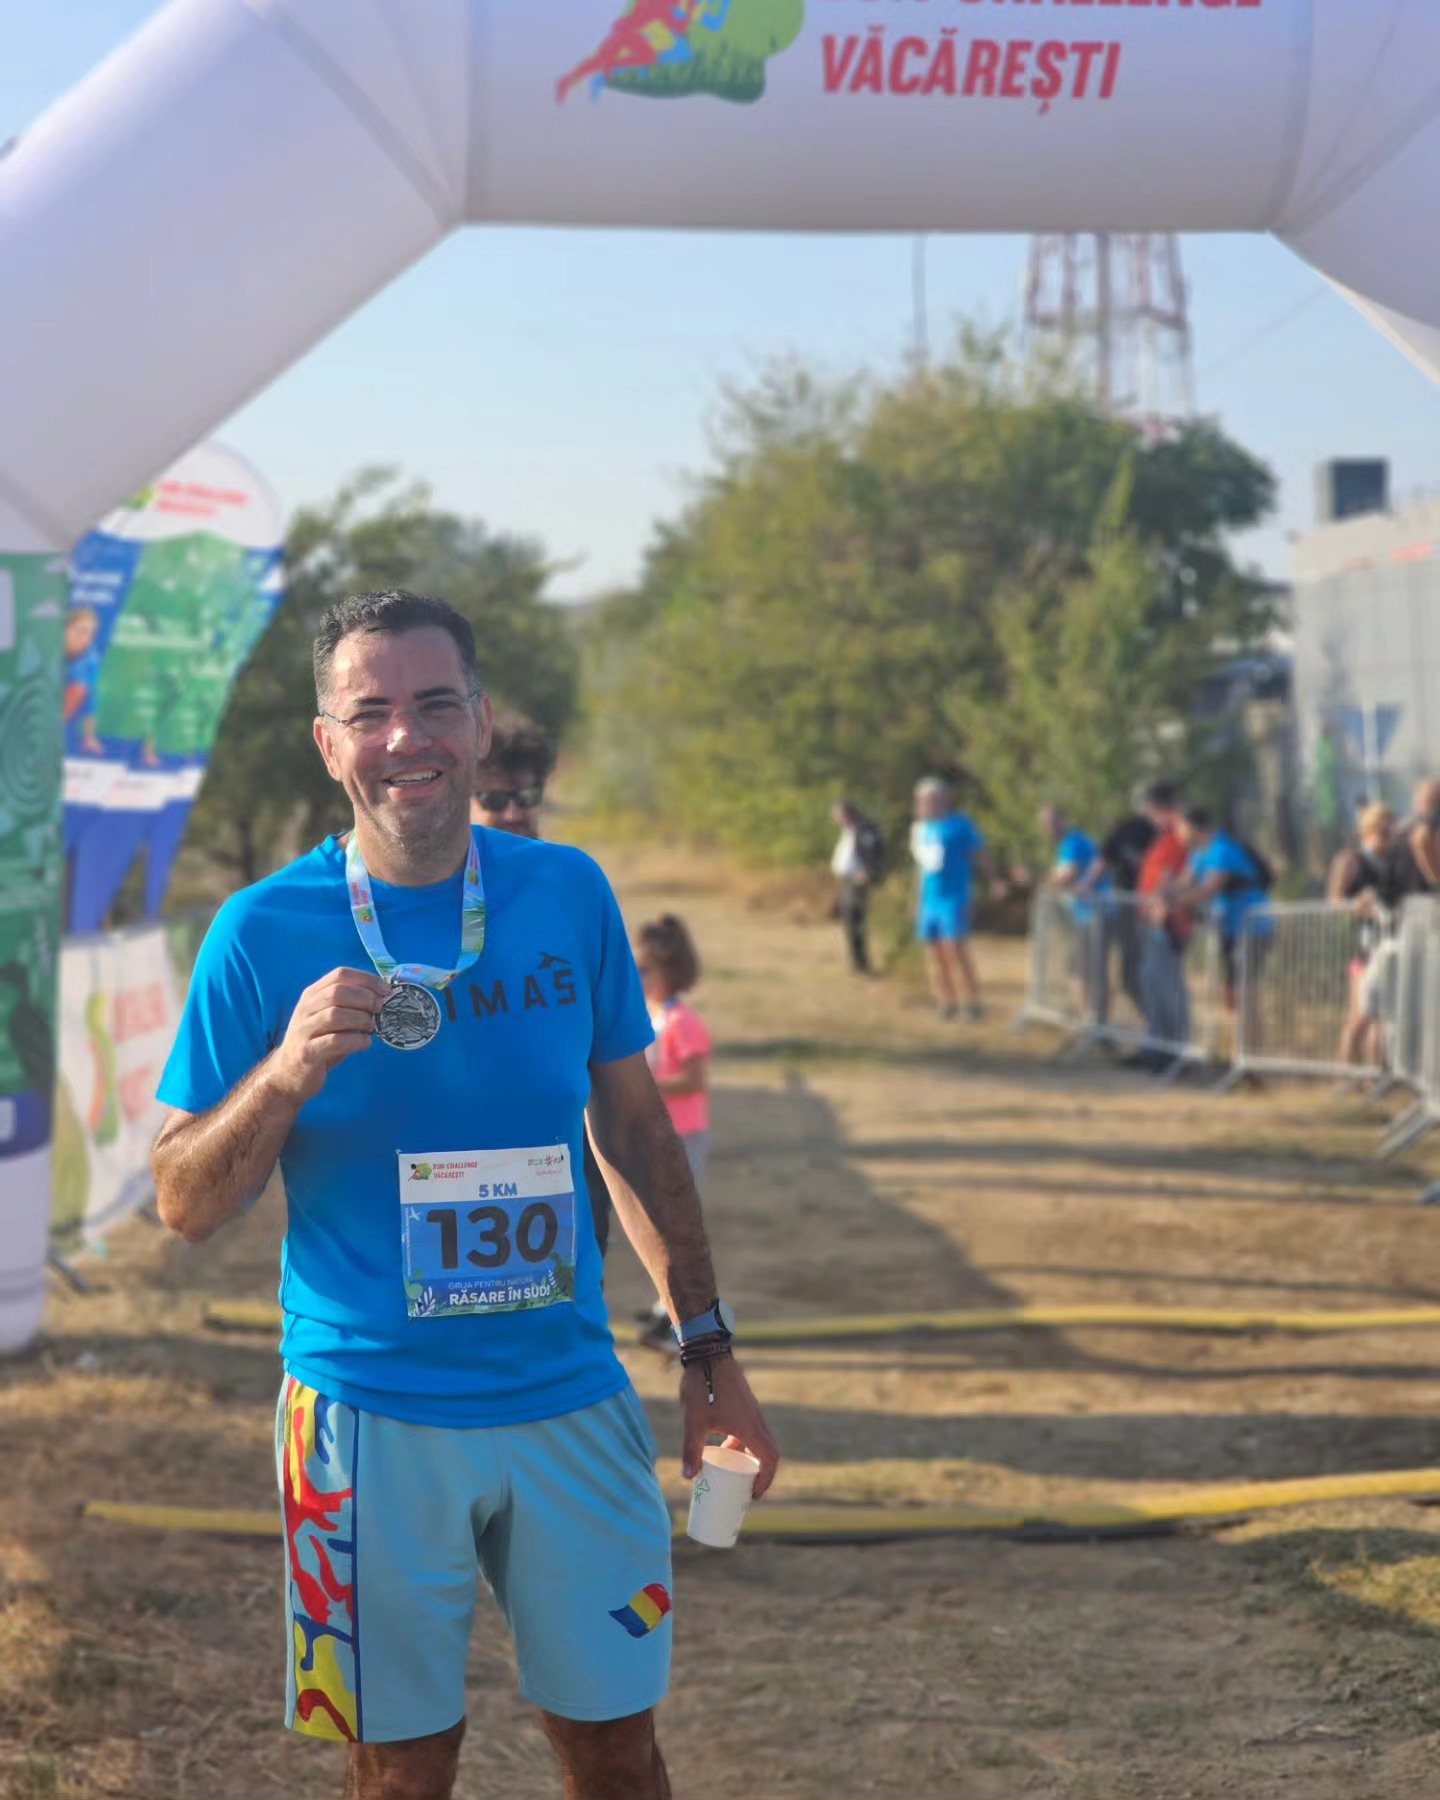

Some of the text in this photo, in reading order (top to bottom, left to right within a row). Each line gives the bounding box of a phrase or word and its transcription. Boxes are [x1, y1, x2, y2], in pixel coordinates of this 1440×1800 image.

[822, 24, 1122, 115] VĂCĂREȘTI
[478, 1182, 518, 1198] 5 KM
[426, 1202, 558, 1269] 130
[449, 1285, 551, 1306] RĂSARE ÎN SUD!
